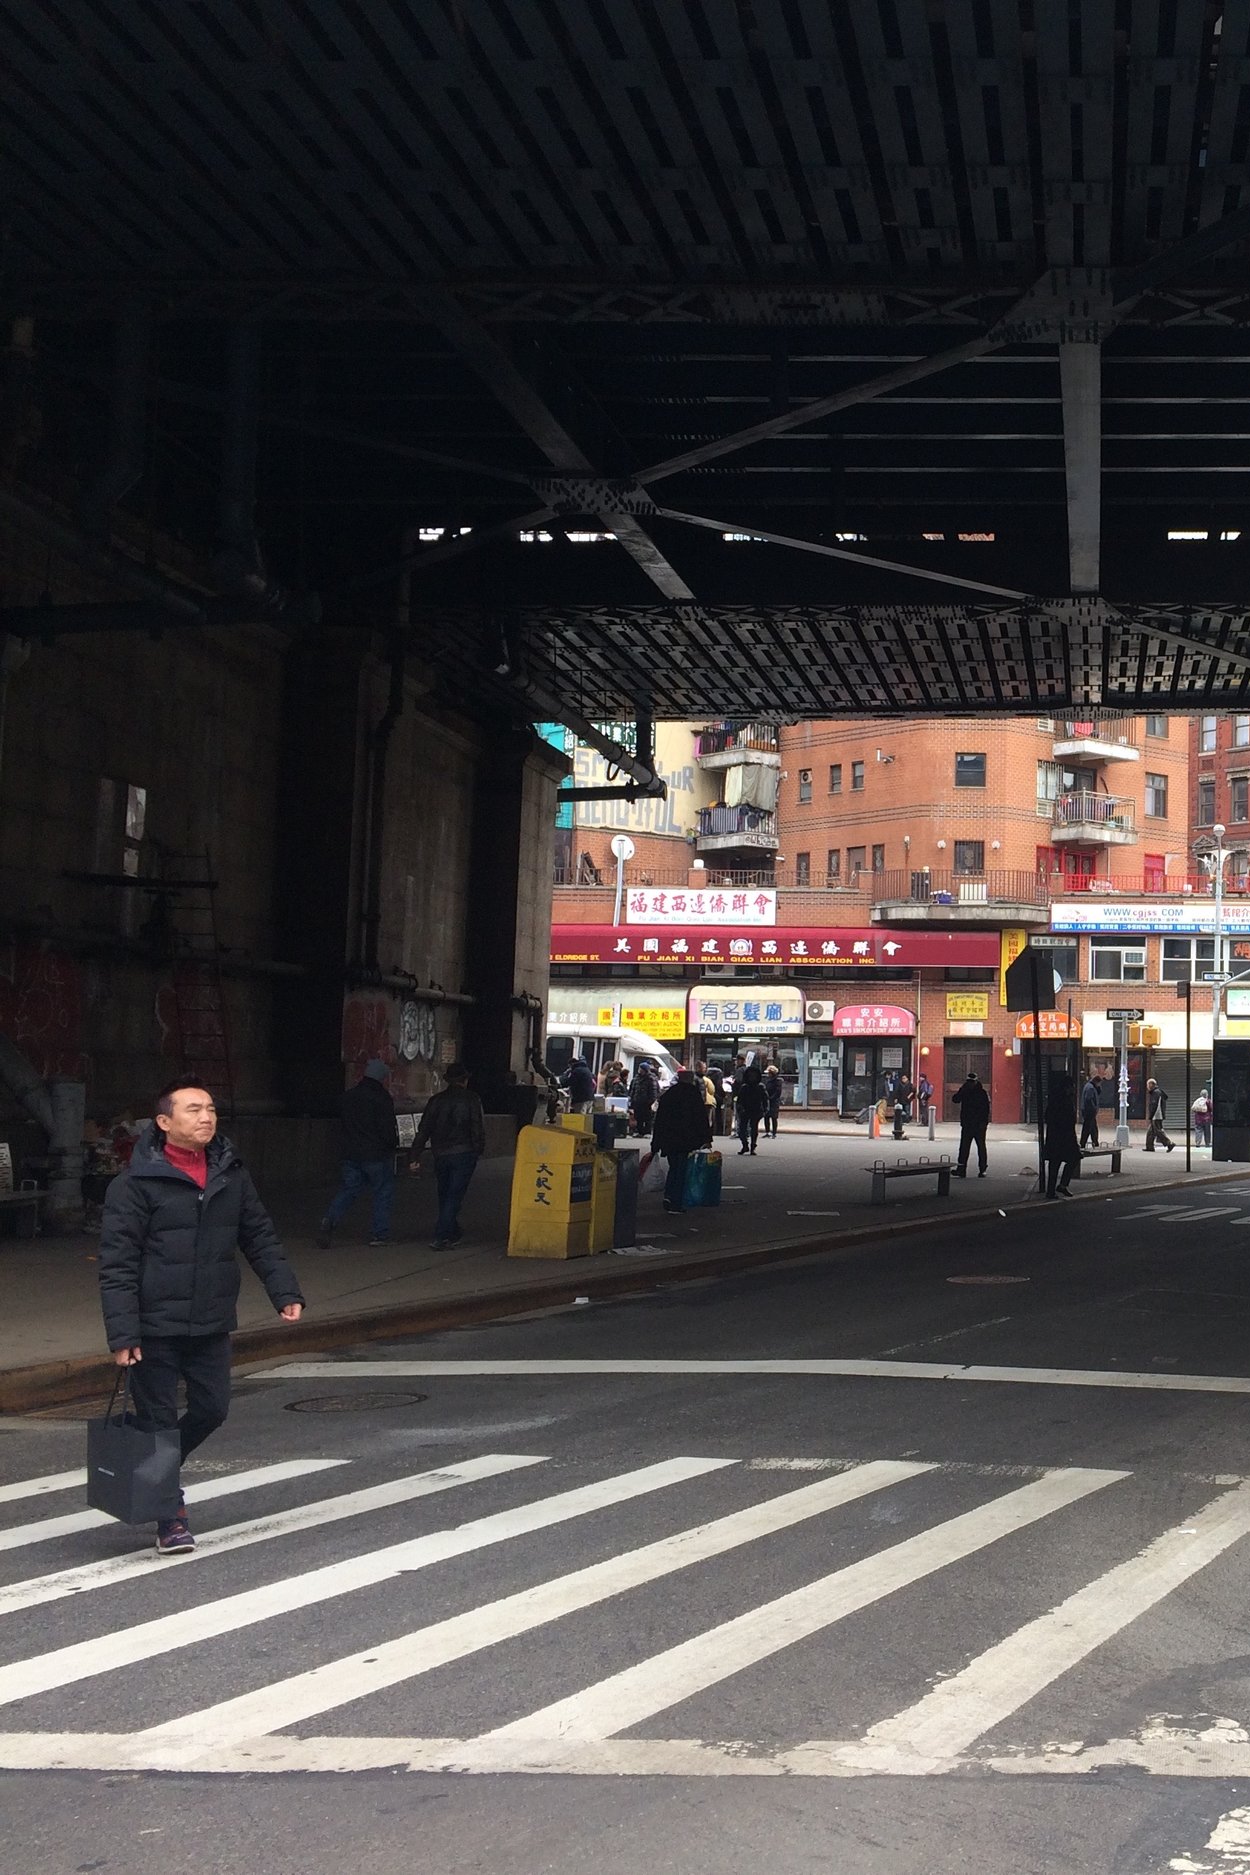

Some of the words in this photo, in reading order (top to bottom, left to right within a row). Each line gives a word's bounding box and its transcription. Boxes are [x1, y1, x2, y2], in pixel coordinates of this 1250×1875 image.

[700, 1002, 782, 1021] 有名髮廊
[699, 1023, 745, 1033] FAMOUS
